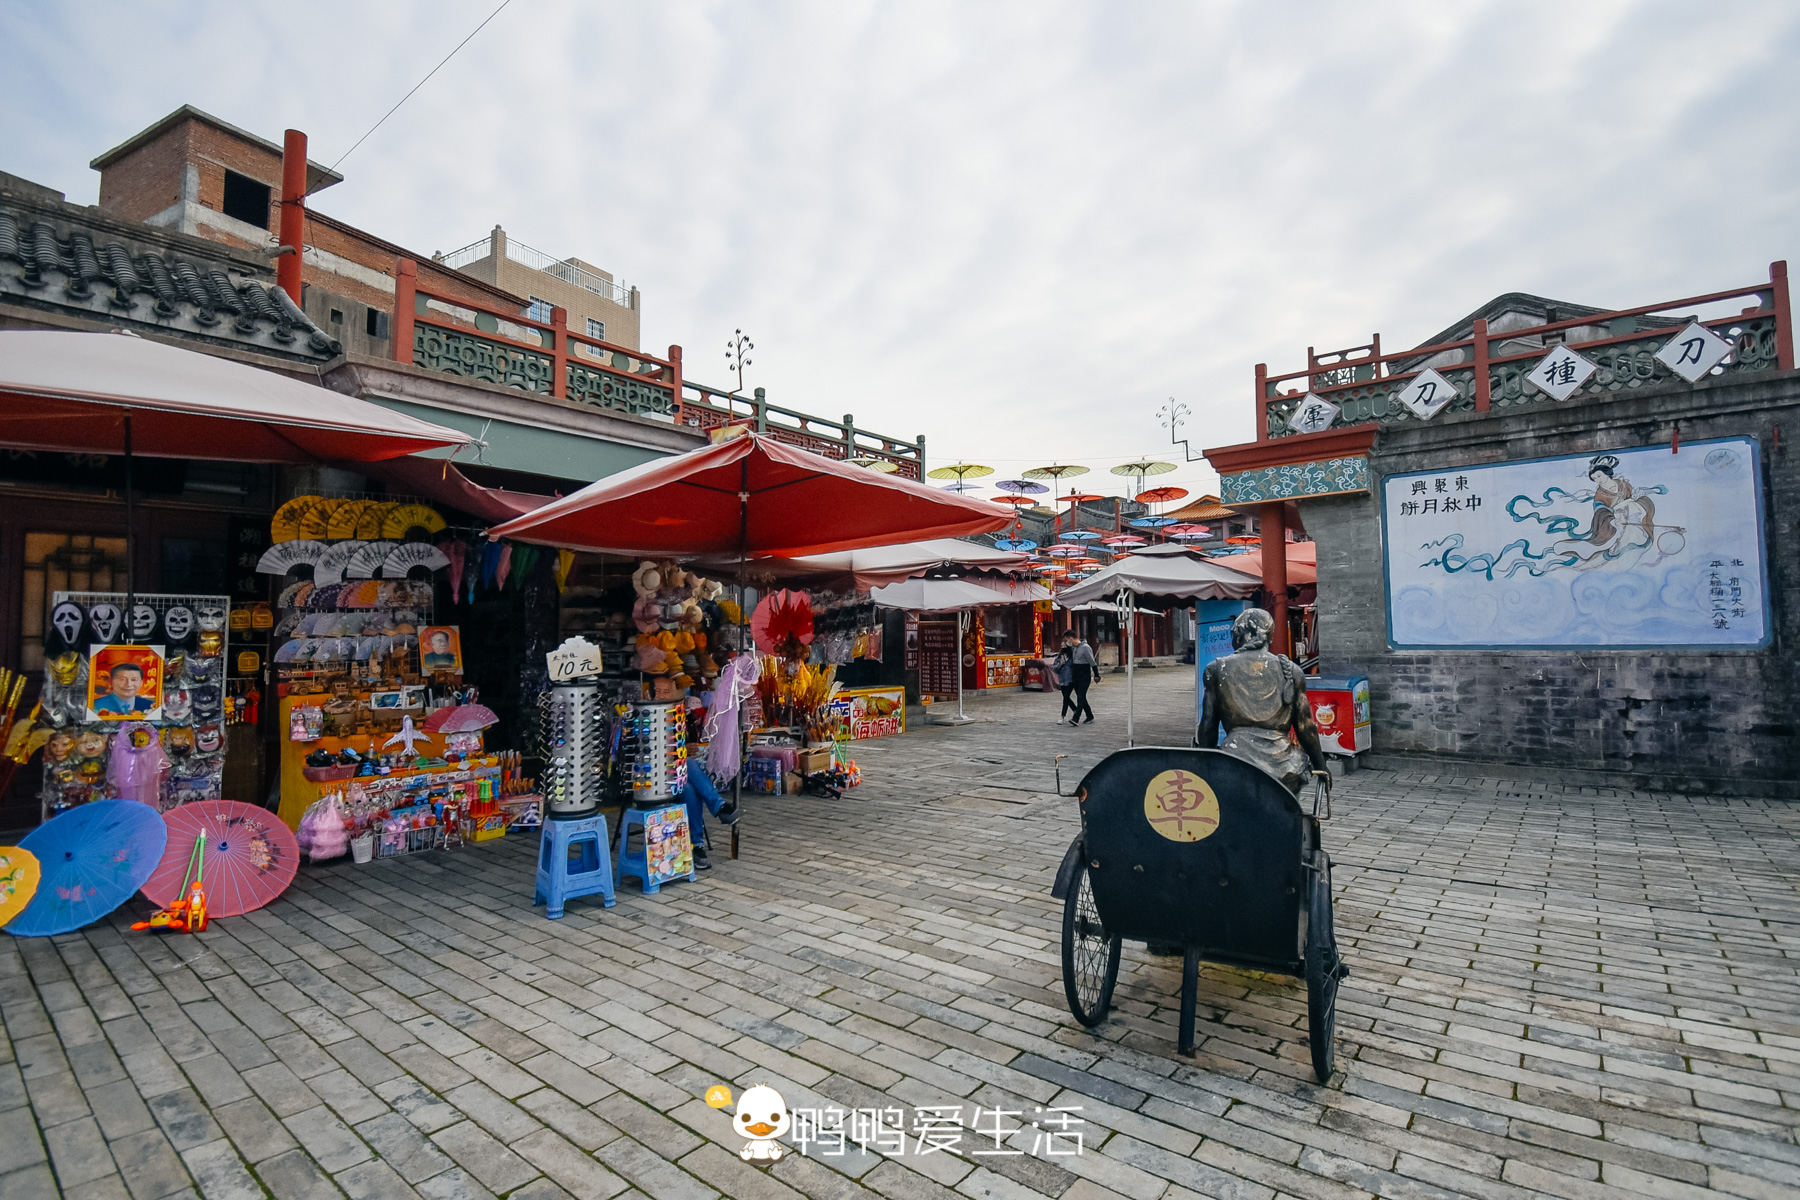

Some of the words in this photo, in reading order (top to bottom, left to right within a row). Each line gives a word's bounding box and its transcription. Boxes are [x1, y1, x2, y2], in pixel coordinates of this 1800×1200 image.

[1413, 381, 1437, 405] 刀
[1543, 357, 1578, 386] 種
[1676, 337, 1705, 366] 刀
[1209, 624, 1231, 632] Meco
